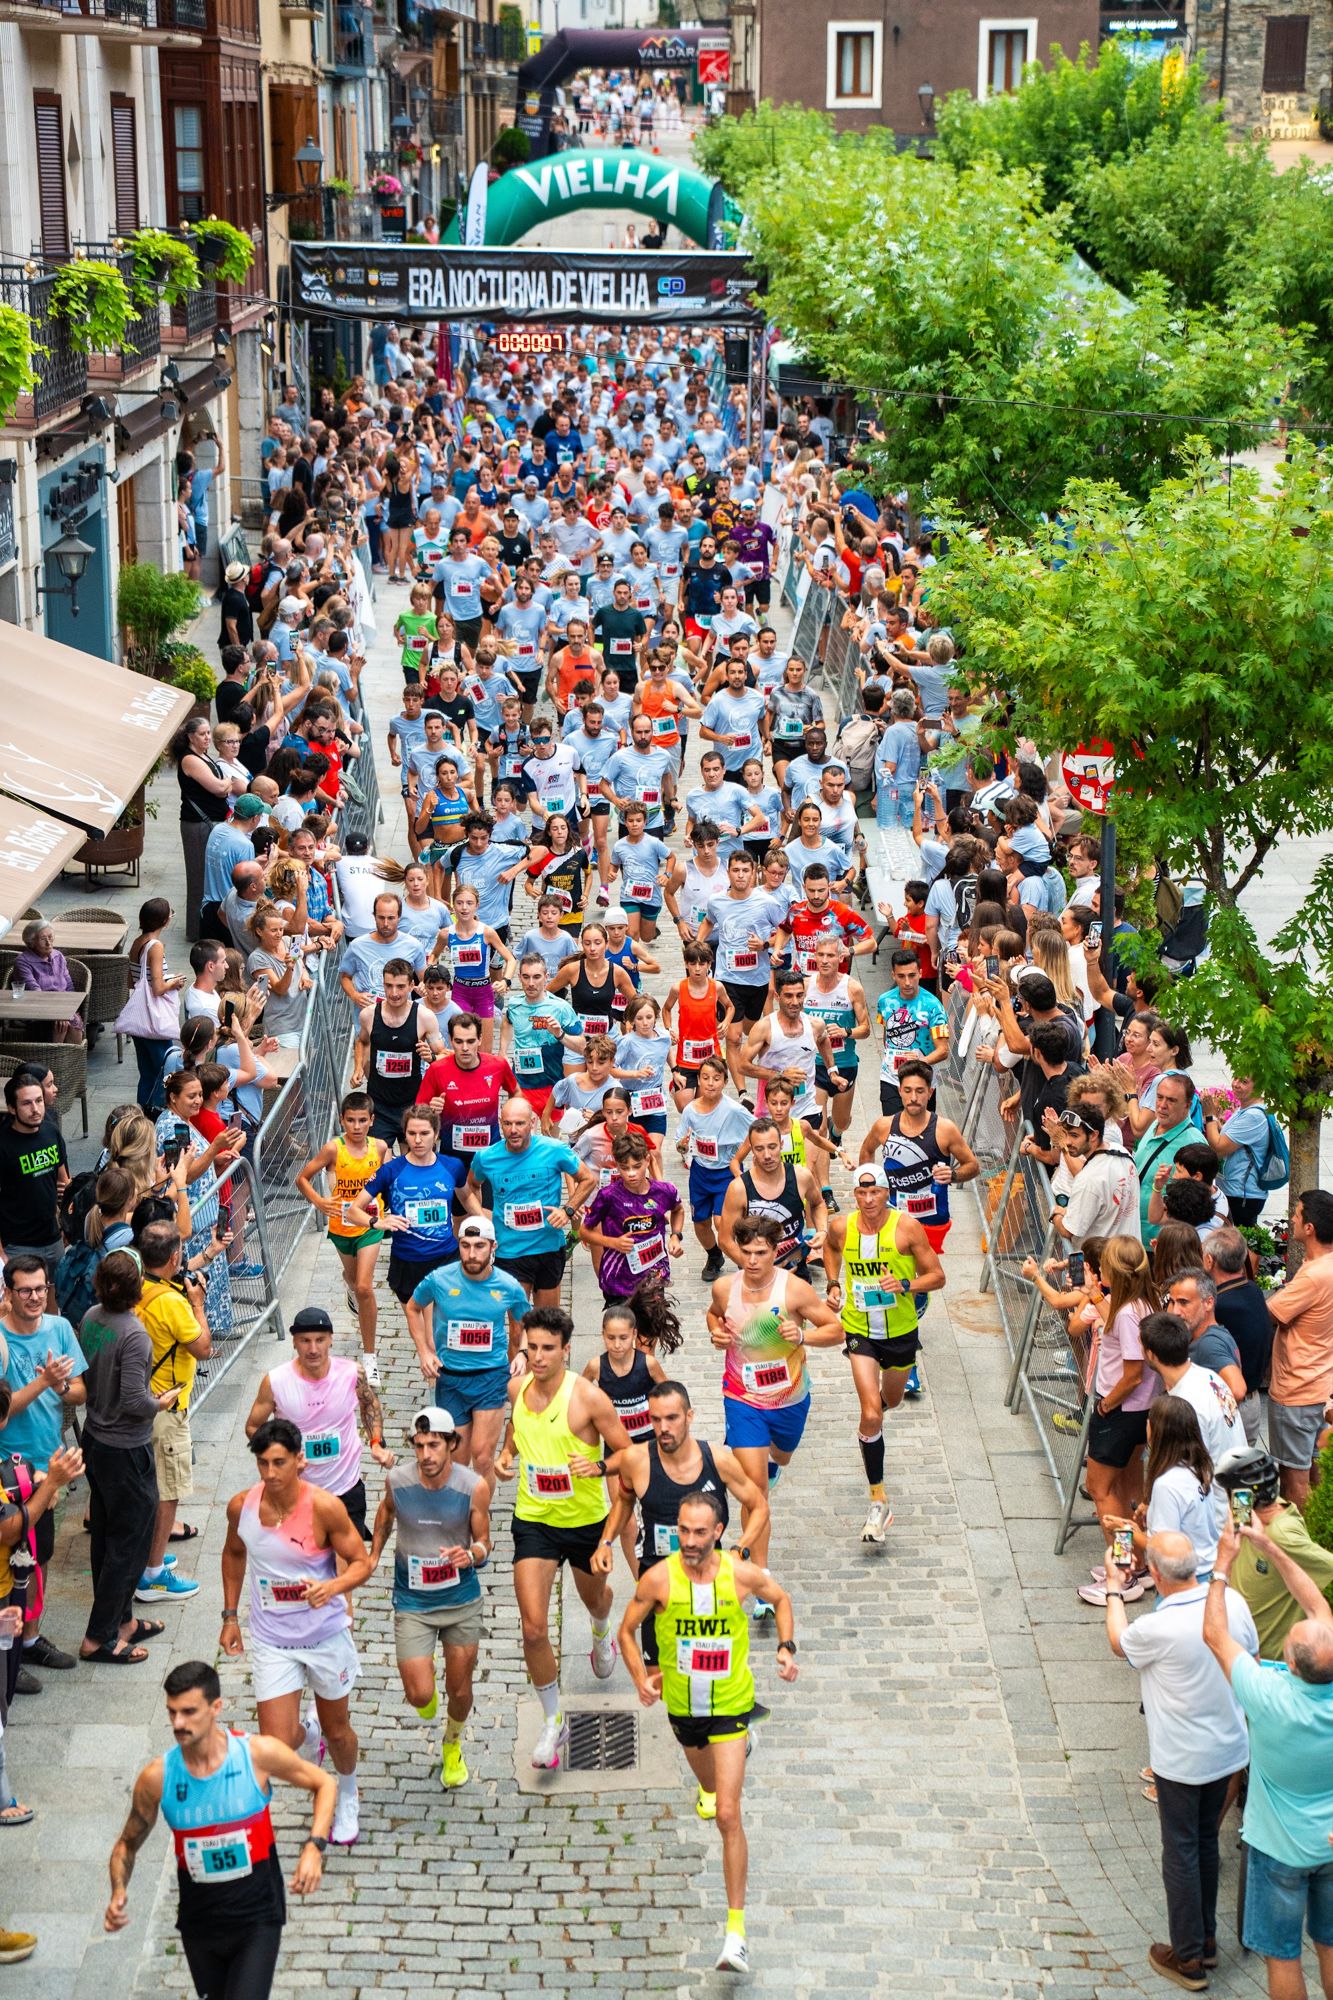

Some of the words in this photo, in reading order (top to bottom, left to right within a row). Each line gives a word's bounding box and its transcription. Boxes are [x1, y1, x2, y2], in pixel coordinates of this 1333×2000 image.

[638, 47, 663, 58] VAL
[515, 158, 680, 216] VIELHA
[408, 267, 447, 307] ERA
[449, 268, 550, 309] NOCTURNA
[552, 270, 578, 309] DE
[578, 271, 650, 311] VIELHA
[471, 979, 489, 987] PRO
[523, 1056, 535, 1068] 43
[465, 1135, 487, 1147] 1126
[19, 1145, 60, 1174] ELLESSE
[337, 1178, 370, 1189] RUNNE
[889, 1166, 934, 1188] Tossal
[423, 1209, 441, 1223] 50
[627, 1220, 653, 1232] Trigo
[461, 1331, 491, 1346] 1056
[758, 1369, 787, 1386] 1185
[612, 1394, 647, 1406] ALOMON
[313, 1442, 332, 1458] 86
[539, 1477, 569, 1492] 1201
[674, 1618, 731, 1637] IRWL
[697, 1652, 725, 1670] 1111
[211, 1849, 238, 1871] 55
